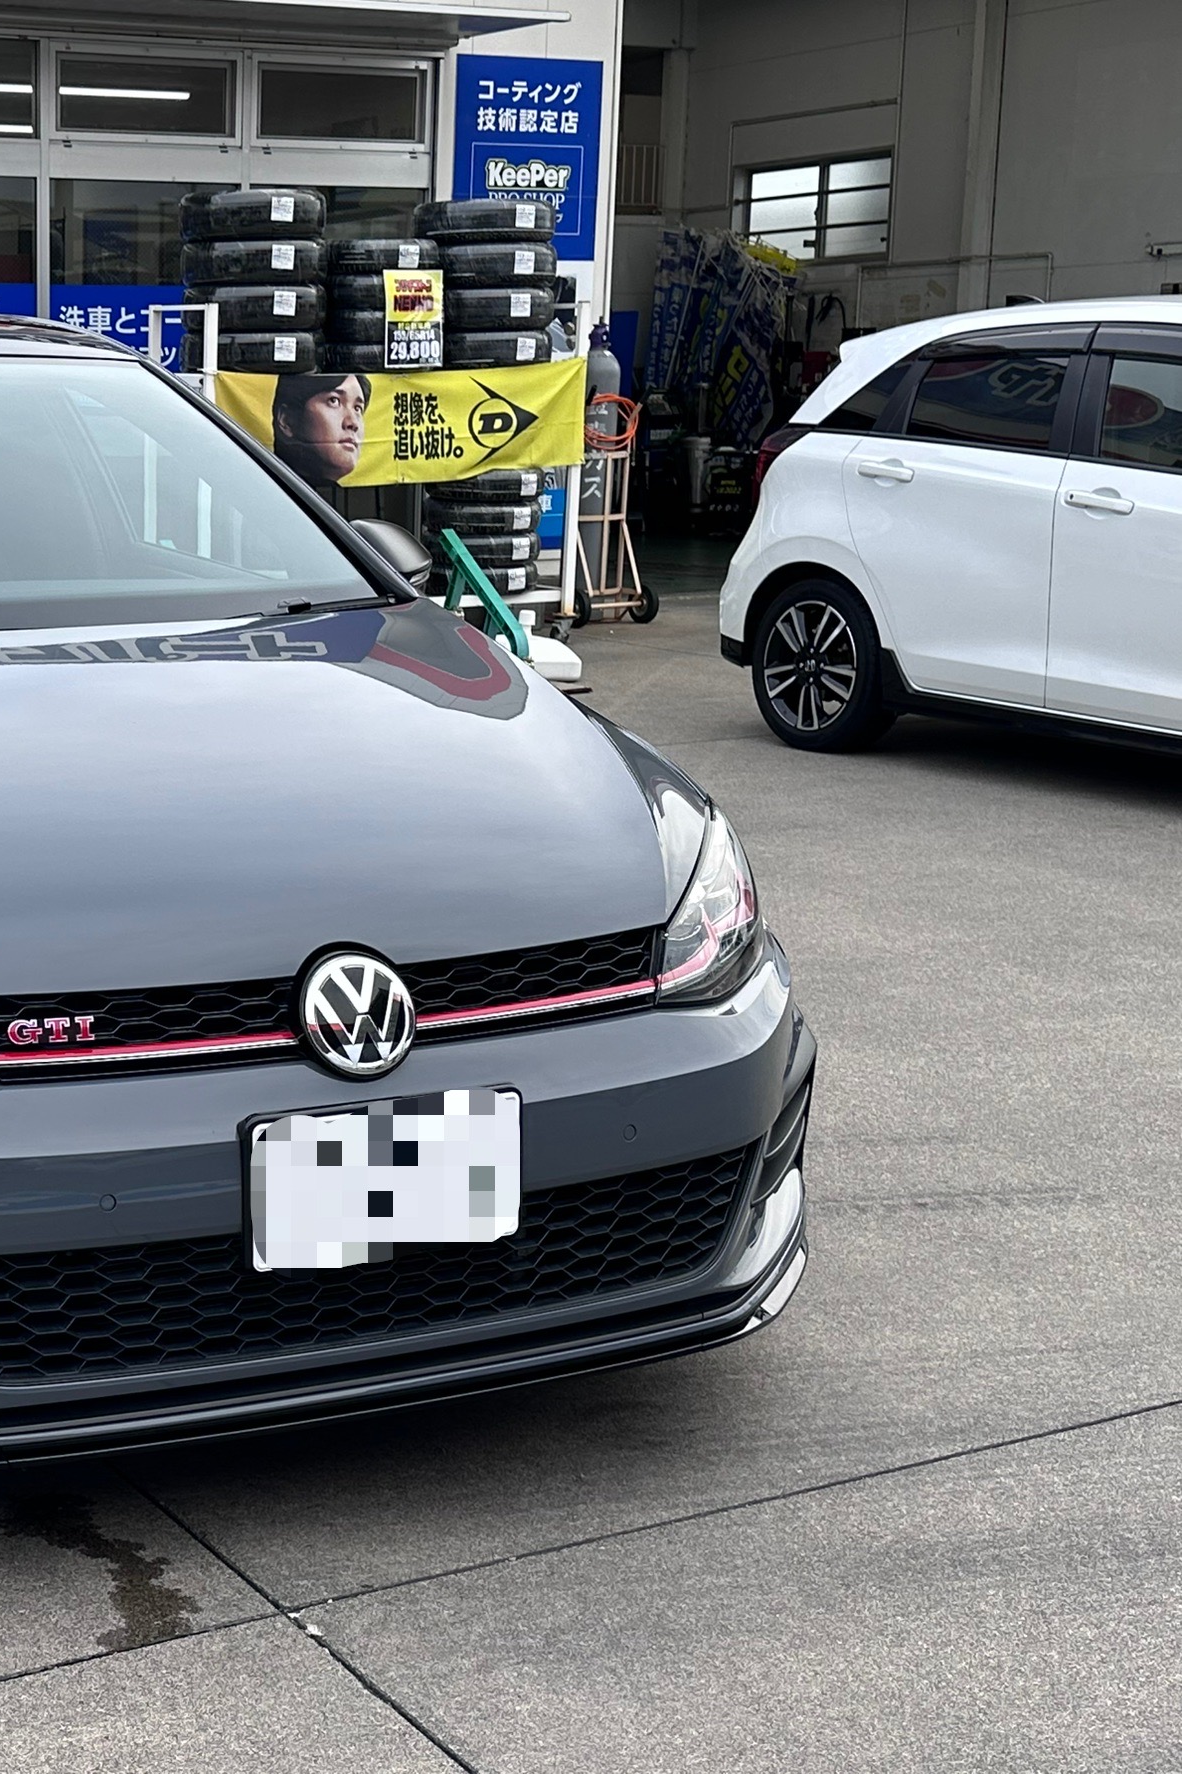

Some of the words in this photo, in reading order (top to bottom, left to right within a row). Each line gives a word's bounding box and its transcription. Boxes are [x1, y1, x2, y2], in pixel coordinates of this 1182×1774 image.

[478, 80, 582, 105] コーティング
[477, 106, 579, 134] 技術認定店
[487, 160, 570, 189] KeePer
[390, 340, 440, 361] 29,800
[393, 391, 446, 426] 想像を、
[393, 426, 464, 461] 追い抜け。
[7, 1015, 96, 1046] GTI
